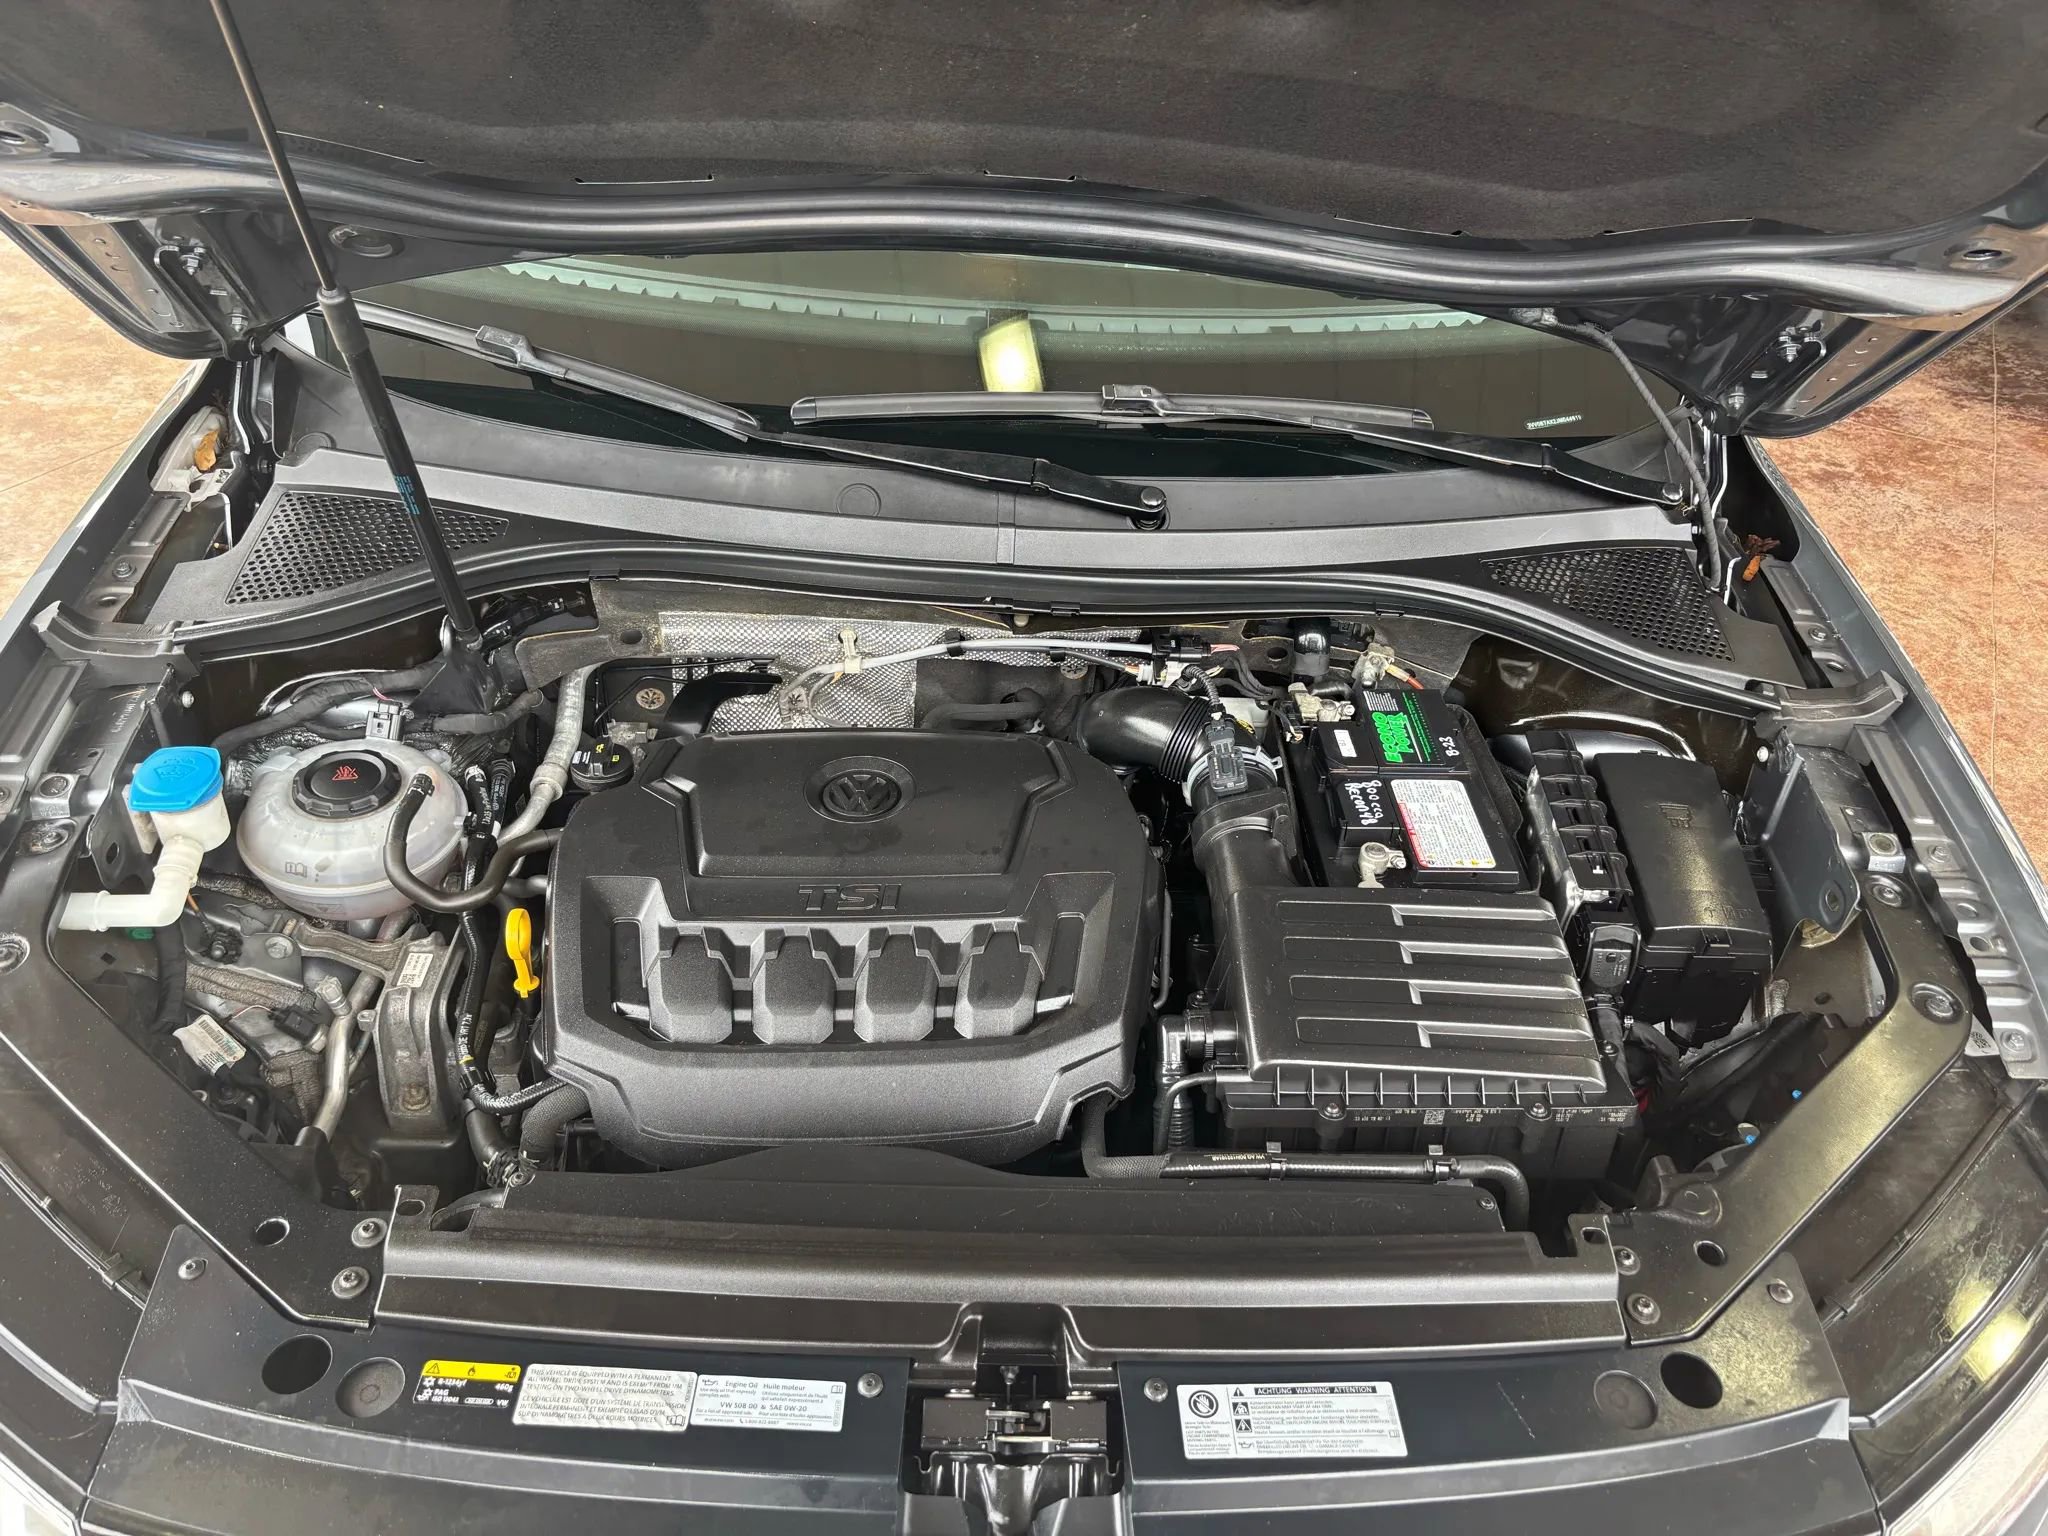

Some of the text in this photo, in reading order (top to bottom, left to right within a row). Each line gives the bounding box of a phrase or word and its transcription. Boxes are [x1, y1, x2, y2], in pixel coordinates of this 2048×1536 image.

[1371, 711, 1404, 763] ECONO
[1387, 712, 1415, 753] POWER
[1361, 779, 1383, 801] 800
[799, 883, 902, 911] TSI
[579, 1370, 609, 1378] EQUIPPED
[634, 1374, 671, 1382] PERMANENT
[494, 1383, 514, 1394] 460g
[629, 1380, 652, 1388] EXEMPT
[725, 1380, 748, 1389] Engine
[434, 1388, 450, 1396] PAG
[1257, 1387, 1293, 1395] ACHTUNG
[496, 1399, 510, 1407] VW
